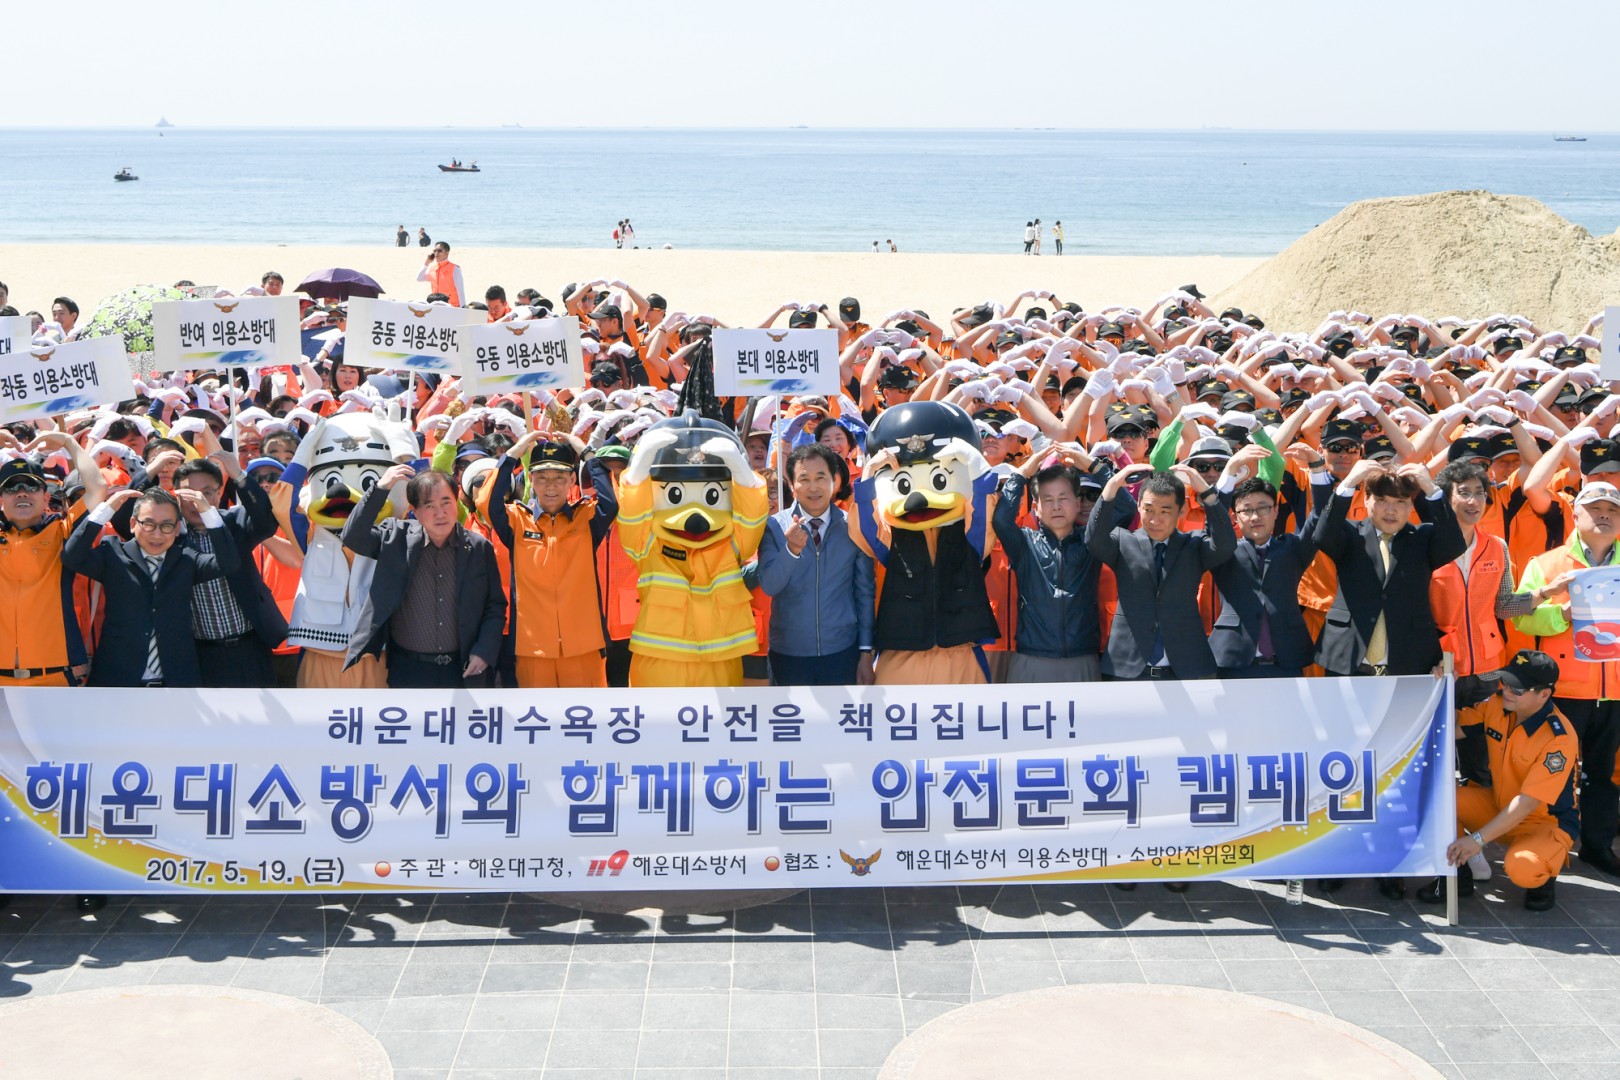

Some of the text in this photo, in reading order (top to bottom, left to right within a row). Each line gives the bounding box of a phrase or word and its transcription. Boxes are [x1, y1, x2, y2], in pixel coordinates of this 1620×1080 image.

[180, 319, 276, 347] 반여 의용소방대
[371, 320, 396, 347] 중동
[476, 339, 569, 372] 우동 의용소방대
[737, 350, 820, 374] 본대 의용소방대
[1, 361, 99, 400] 좌동 의용소방대
[328, 700, 1076, 745] 해운대해수욕장 안전을 책임집니다!
[26, 749, 1377, 841] 해운대소방서와 함께하는 안전문화 캠페인
[147, 859, 215, 883] 2017.
[223, 860, 247, 883] 5.
[258, 859, 294, 883] 19.
[303, 856, 346, 885] (금)
[468, 857, 573, 879] 해운대구청,
[586, 849, 629, 878] 119
[632, 855, 747, 877] 해운대소방서
[783, 852, 820, 873] 협조
[895, 848, 1006, 871] 해운대소방서
[1017, 846, 1108, 869] 의용소방대
[1129, 843, 1255, 868] 소방안전위원회
